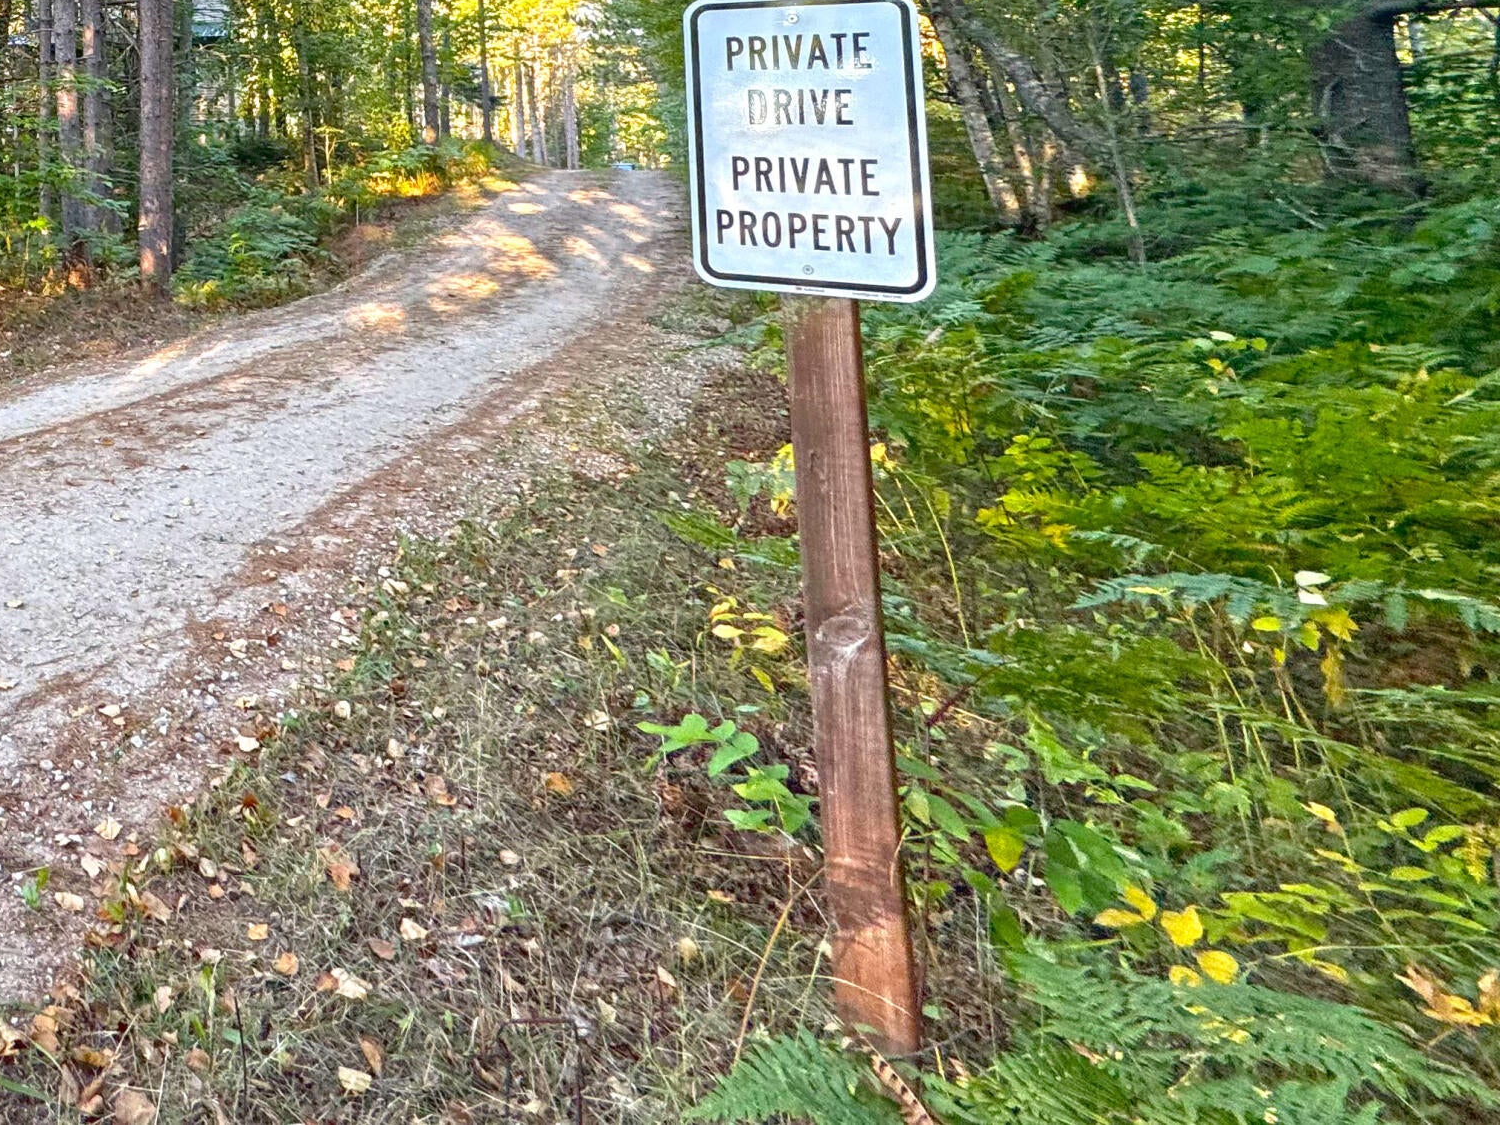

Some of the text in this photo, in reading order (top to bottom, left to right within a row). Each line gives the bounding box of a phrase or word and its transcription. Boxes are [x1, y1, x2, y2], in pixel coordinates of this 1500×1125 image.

[726, 32, 872, 71] PRIVATE
[747, 89, 854, 125] DRIVE
[731, 156, 880, 196] PRIVATE
[716, 209, 902, 256] PROPERTY
